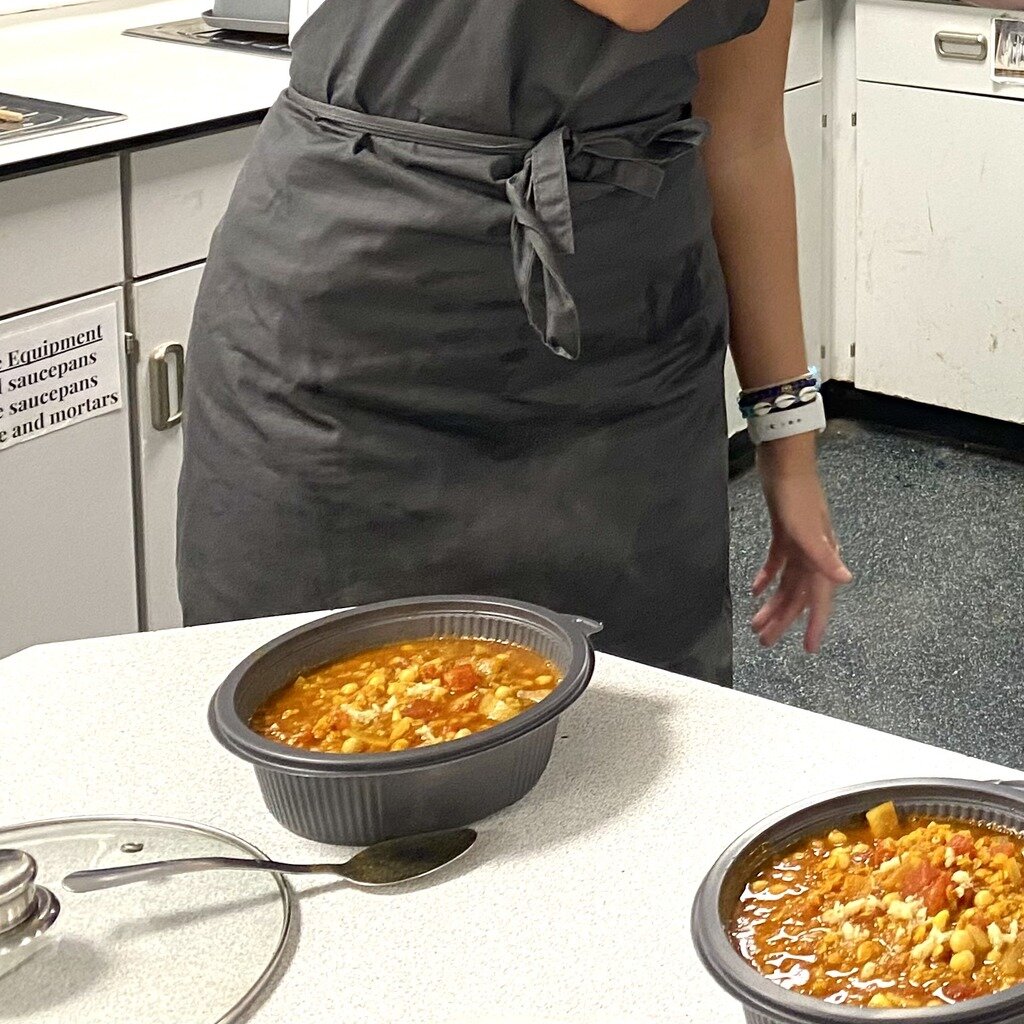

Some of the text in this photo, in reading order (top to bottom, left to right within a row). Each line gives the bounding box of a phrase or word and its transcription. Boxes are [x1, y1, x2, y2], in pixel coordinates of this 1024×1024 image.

[8, 324, 103, 367] Equipment
[8, 352, 97, 392] saucepans
[9, 375, 98, 416] saucepans
[12, 412, 45, 438] and
[50, 392, 119, 425] mortars
